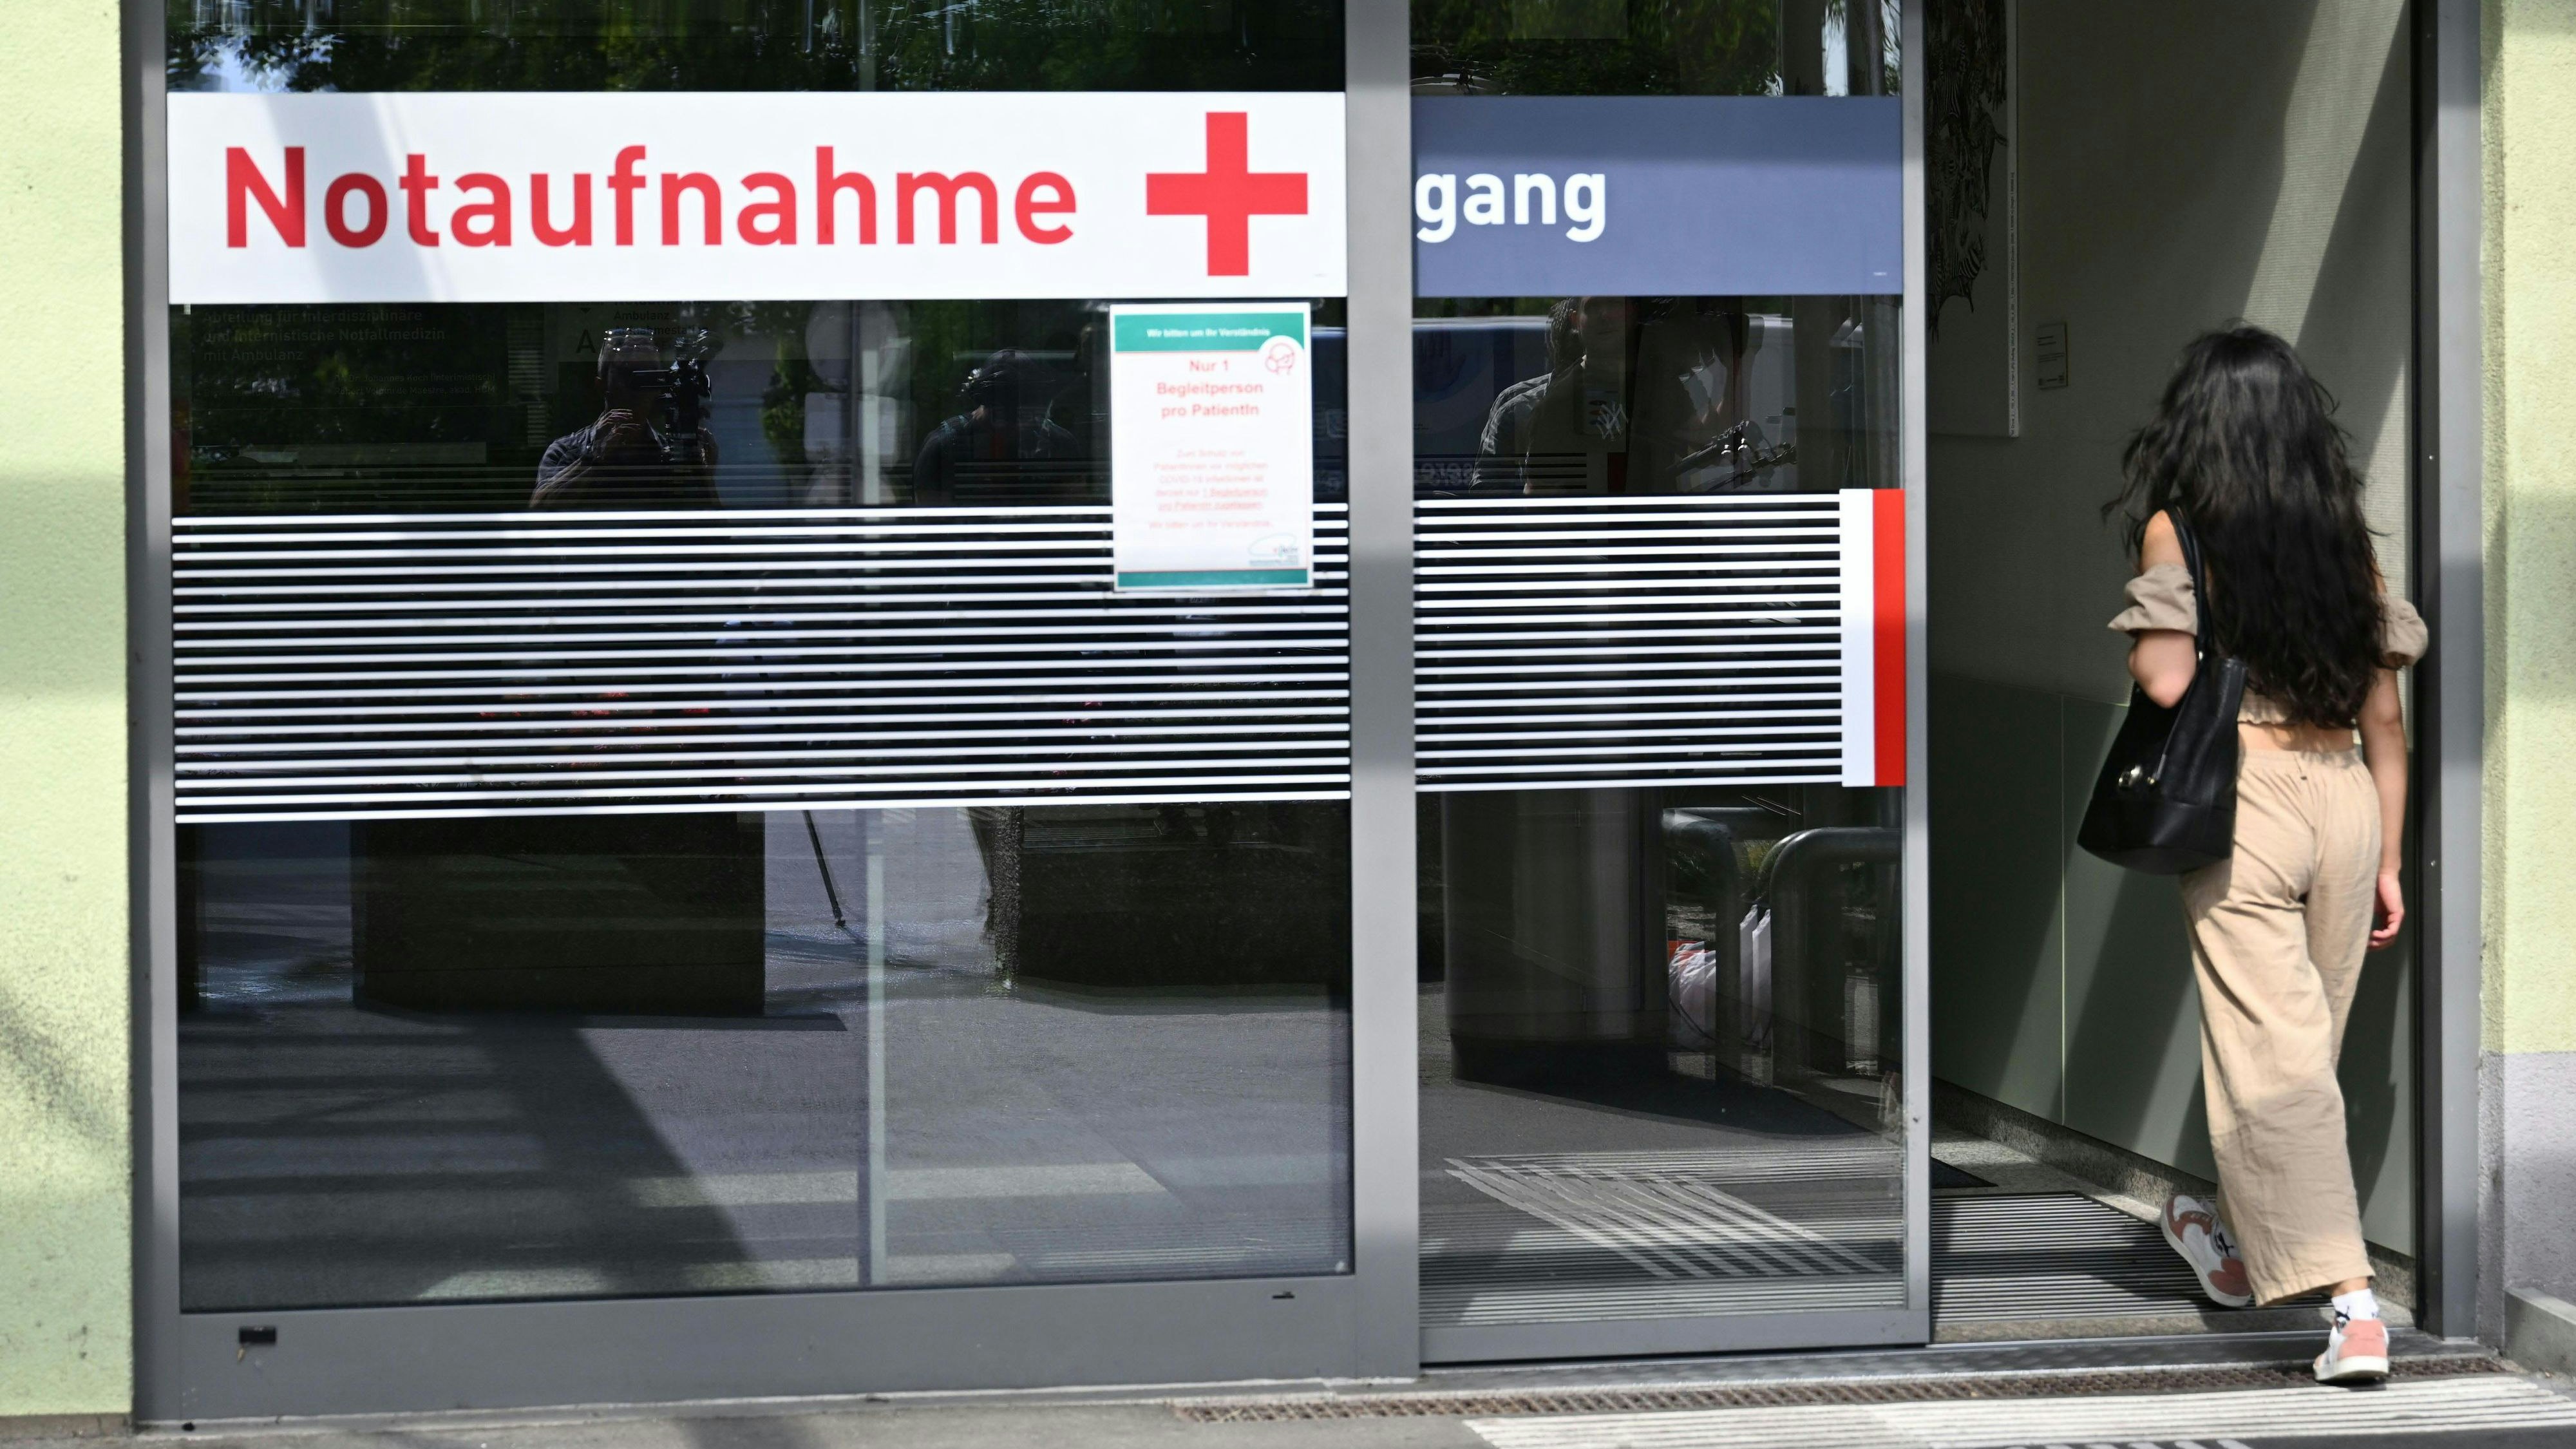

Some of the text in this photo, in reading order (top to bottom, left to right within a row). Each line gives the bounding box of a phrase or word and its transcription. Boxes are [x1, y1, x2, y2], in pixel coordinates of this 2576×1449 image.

[227, 145, 1077, 249] Notaufnahme
[1415, 173, 1605, 242] gang
[203, 311, 272, 325] Abteilung
[277, 310, 298, 323] für
[613, 310, 670, 321] Ambulanz
[339, 327, 446, 341] Notfallmedizin
[575, 328, 597, 354] A
[204, 348, 304, 361] mit Ambulanz
[1189, 359, 1229, 372] Nur 1
[1157, 381, 1264, 397] Begleitperson
[1161, 402, 1260, 419] pro PatientIn
